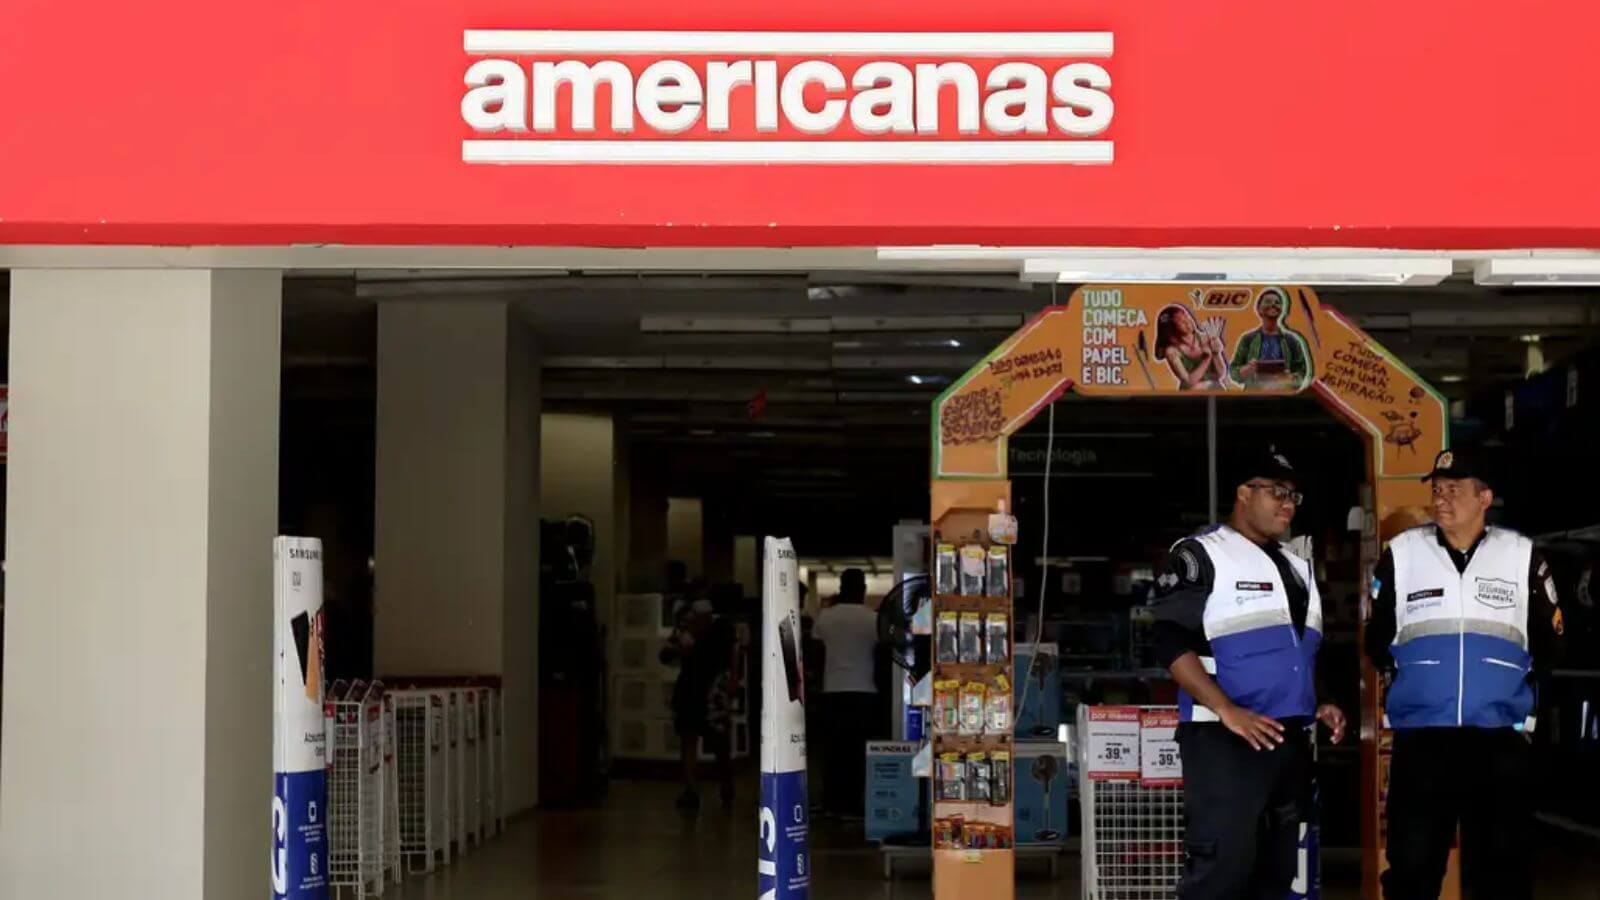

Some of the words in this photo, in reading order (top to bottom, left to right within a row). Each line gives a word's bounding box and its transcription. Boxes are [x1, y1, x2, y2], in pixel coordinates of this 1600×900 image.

[461, 58, 1114, 136] americanas
[1082, 288, 1122, 307] TUDO
[1083, 327, 1116, 345] COM
[1083, 347, 1129, 364] PAPEL
[1082, 367, 1092, 384] E
[1096, 367, 1127, 384] BIC.
[1010, 448, 1097, 468] Tecnologia
[1091, 711, 1107, 721] por
